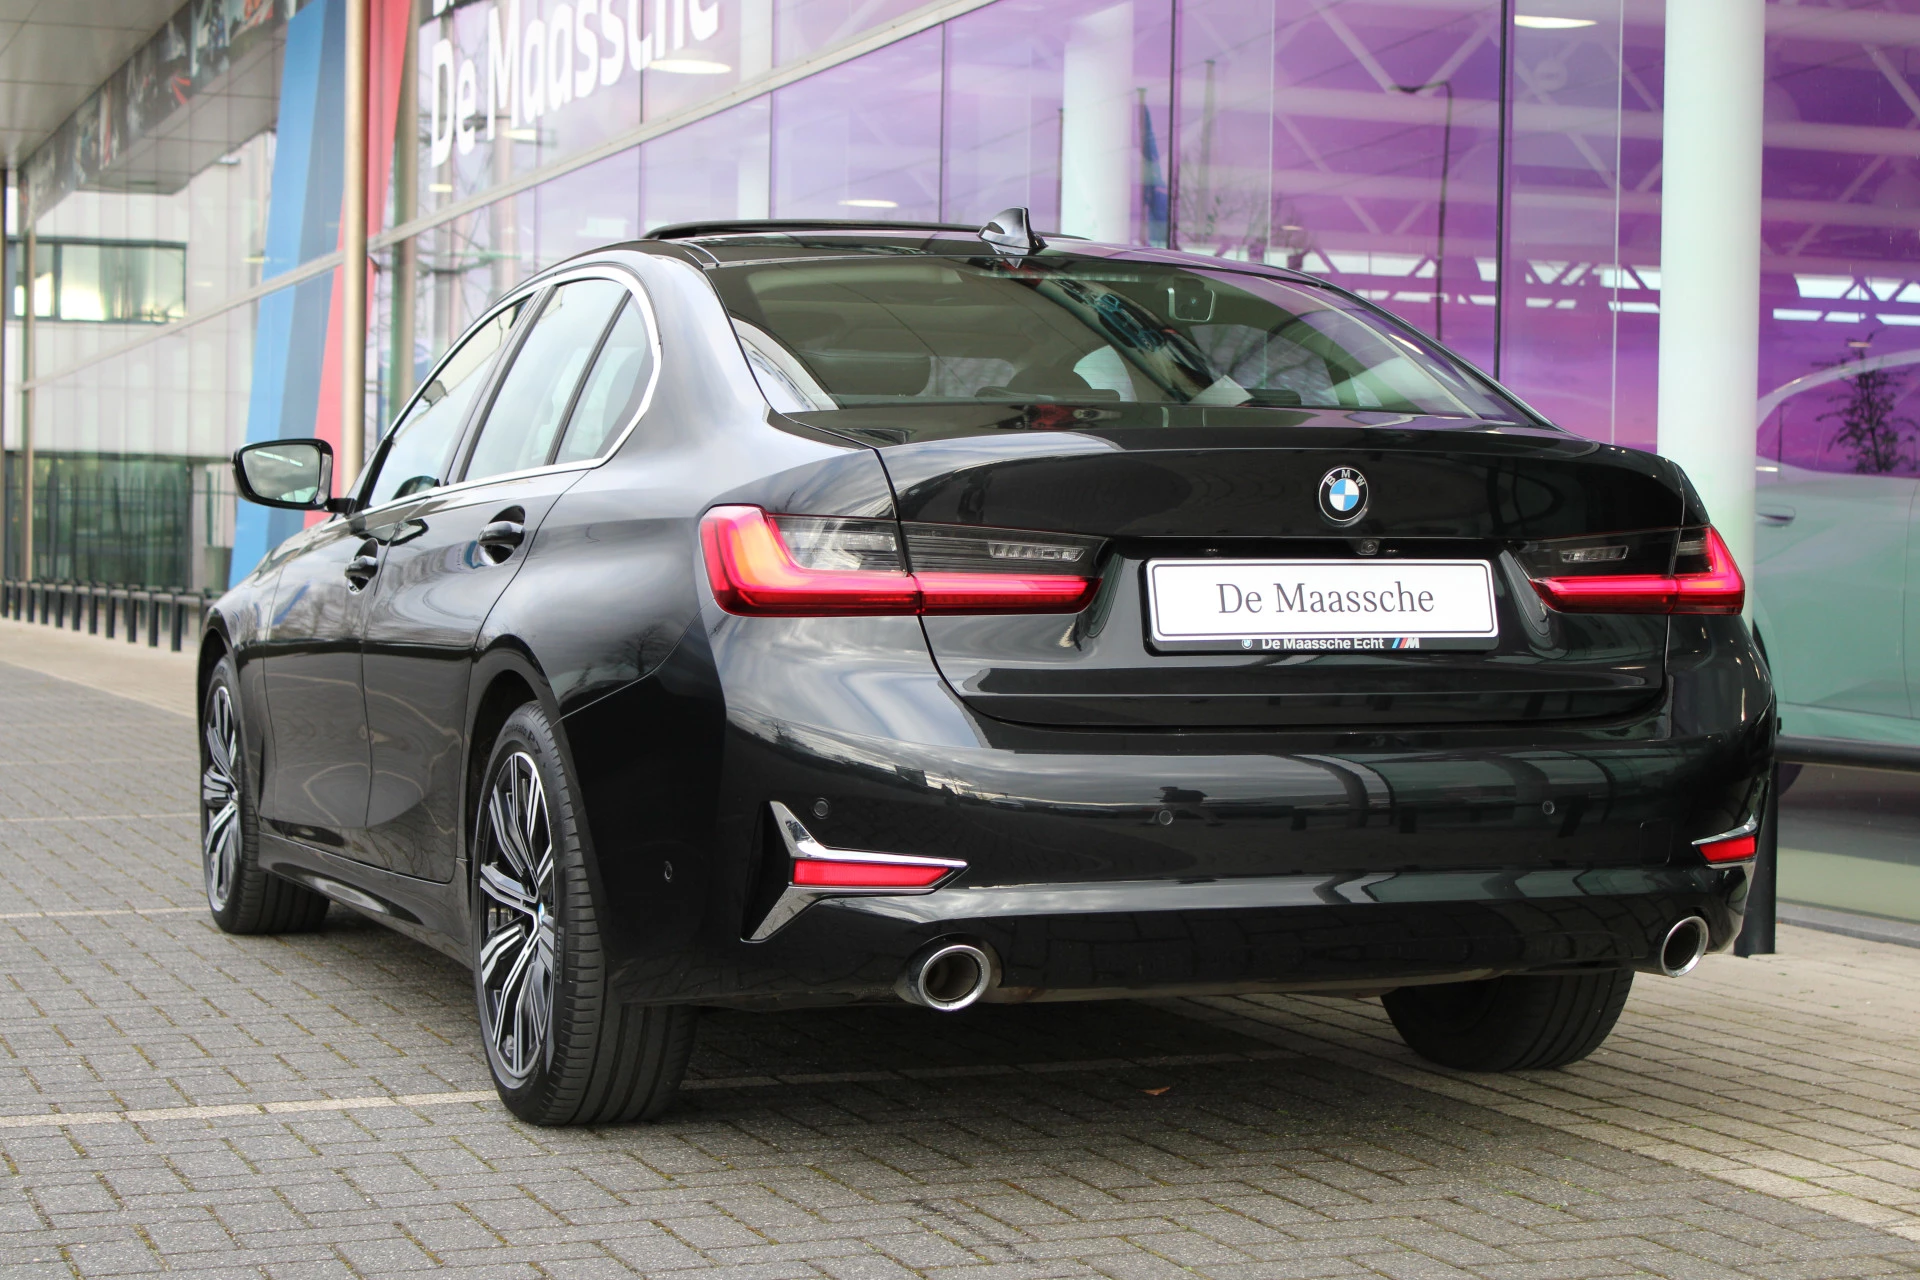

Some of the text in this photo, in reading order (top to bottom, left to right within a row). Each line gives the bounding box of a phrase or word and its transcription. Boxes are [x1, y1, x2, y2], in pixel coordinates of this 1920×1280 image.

[431, 38, 477, 168] De
[325, 469, 366, 487] BMW
[1215, 580, 1435, 614] De Maassche
[1261, 638, 1281, 650] De
[1283, 637, 1352, 650] Maassche
[1353, 637, 1385, 650] Echt
